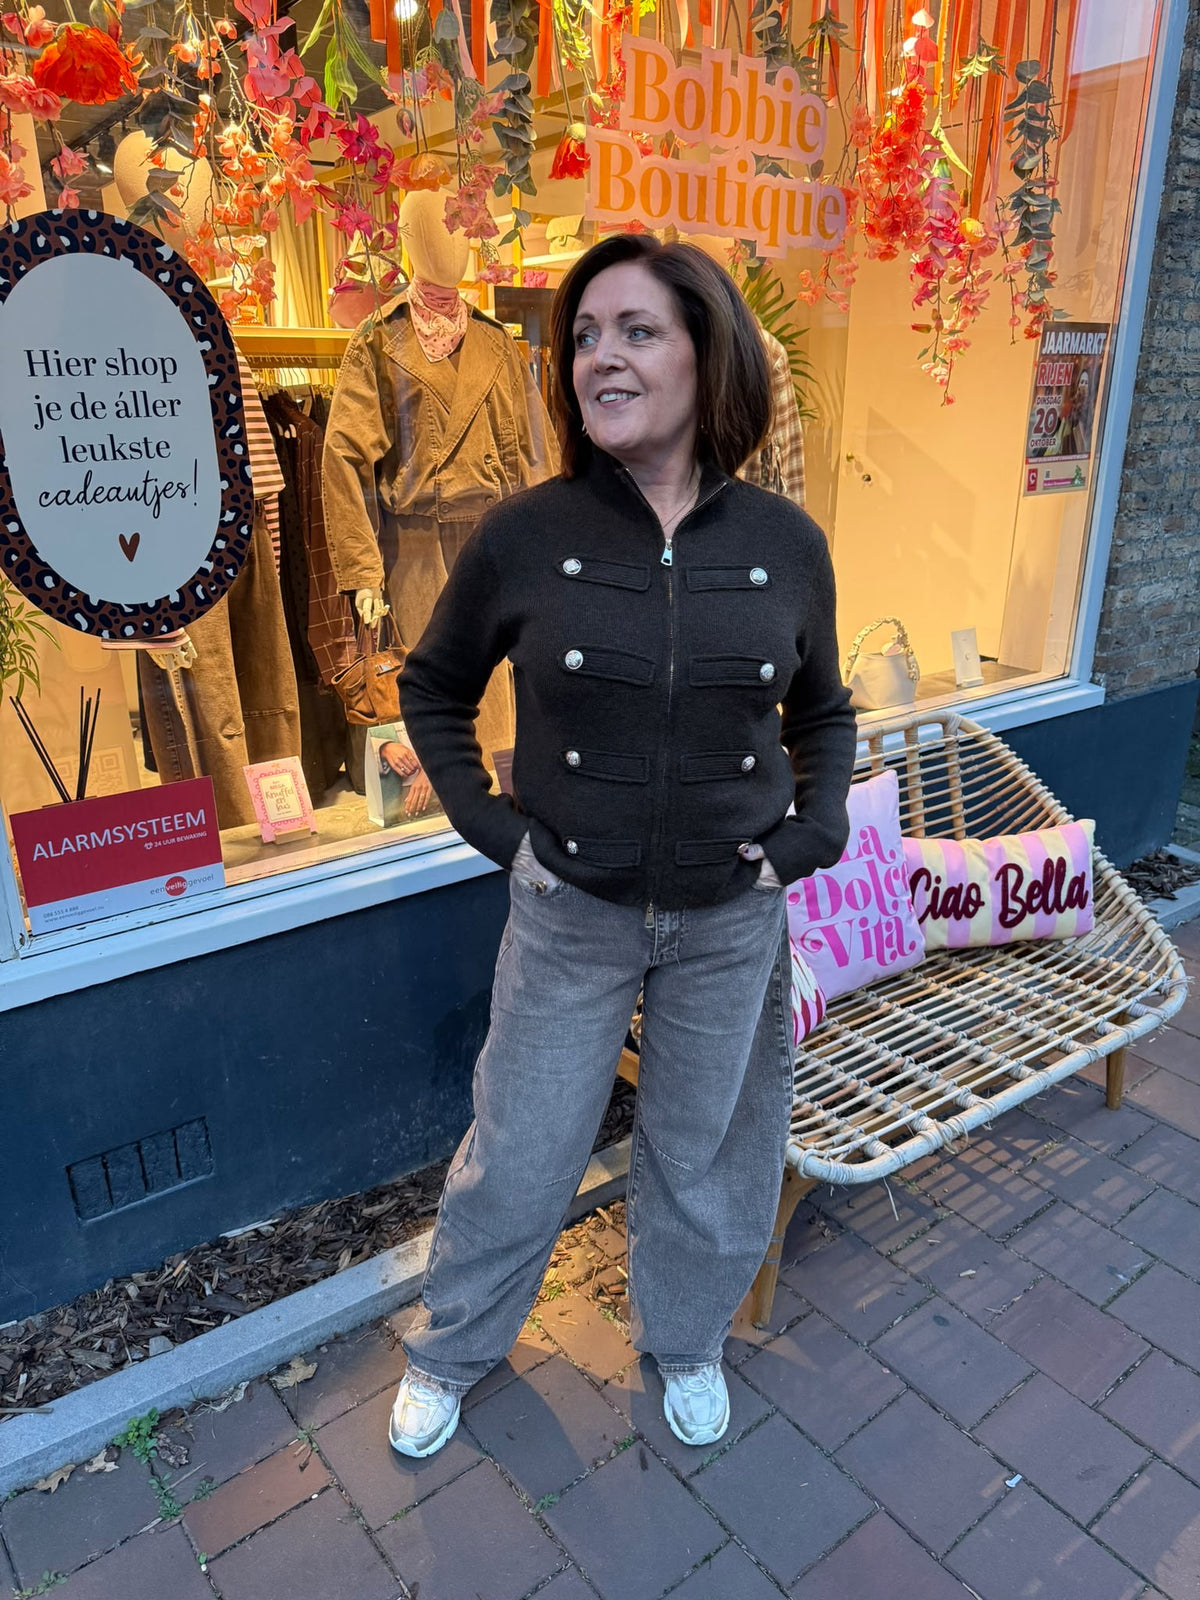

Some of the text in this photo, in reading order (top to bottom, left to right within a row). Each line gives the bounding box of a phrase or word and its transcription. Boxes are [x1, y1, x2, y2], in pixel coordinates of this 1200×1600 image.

[628, 47, 821, 153] Bobbie
[594, 139, 840, 248] Boutique
[1041, 331, 1107, 355] JAARMARKT
[24, 347, 178, 385] Hier shop
[1037, 362, 1074, 387] RIJEN
[33, 390, 181, 430] je de áller
[1036, 395, 1062, 406] DINSDAG
[1033, 407, 1058, 434] 20
[58, 433, 171, 464] leukste
[1030, 438, 1056, 448] OKTOBER
[38, 458, 199, 520] cadeautjes!
[32, 809, 206, 862] ALARMSYSTEEM
[176, 831, 207, 842] BEWAKING
[909, 856, 1089, 929] Ciao Bella
[800, 914, 916, 968] Vita
